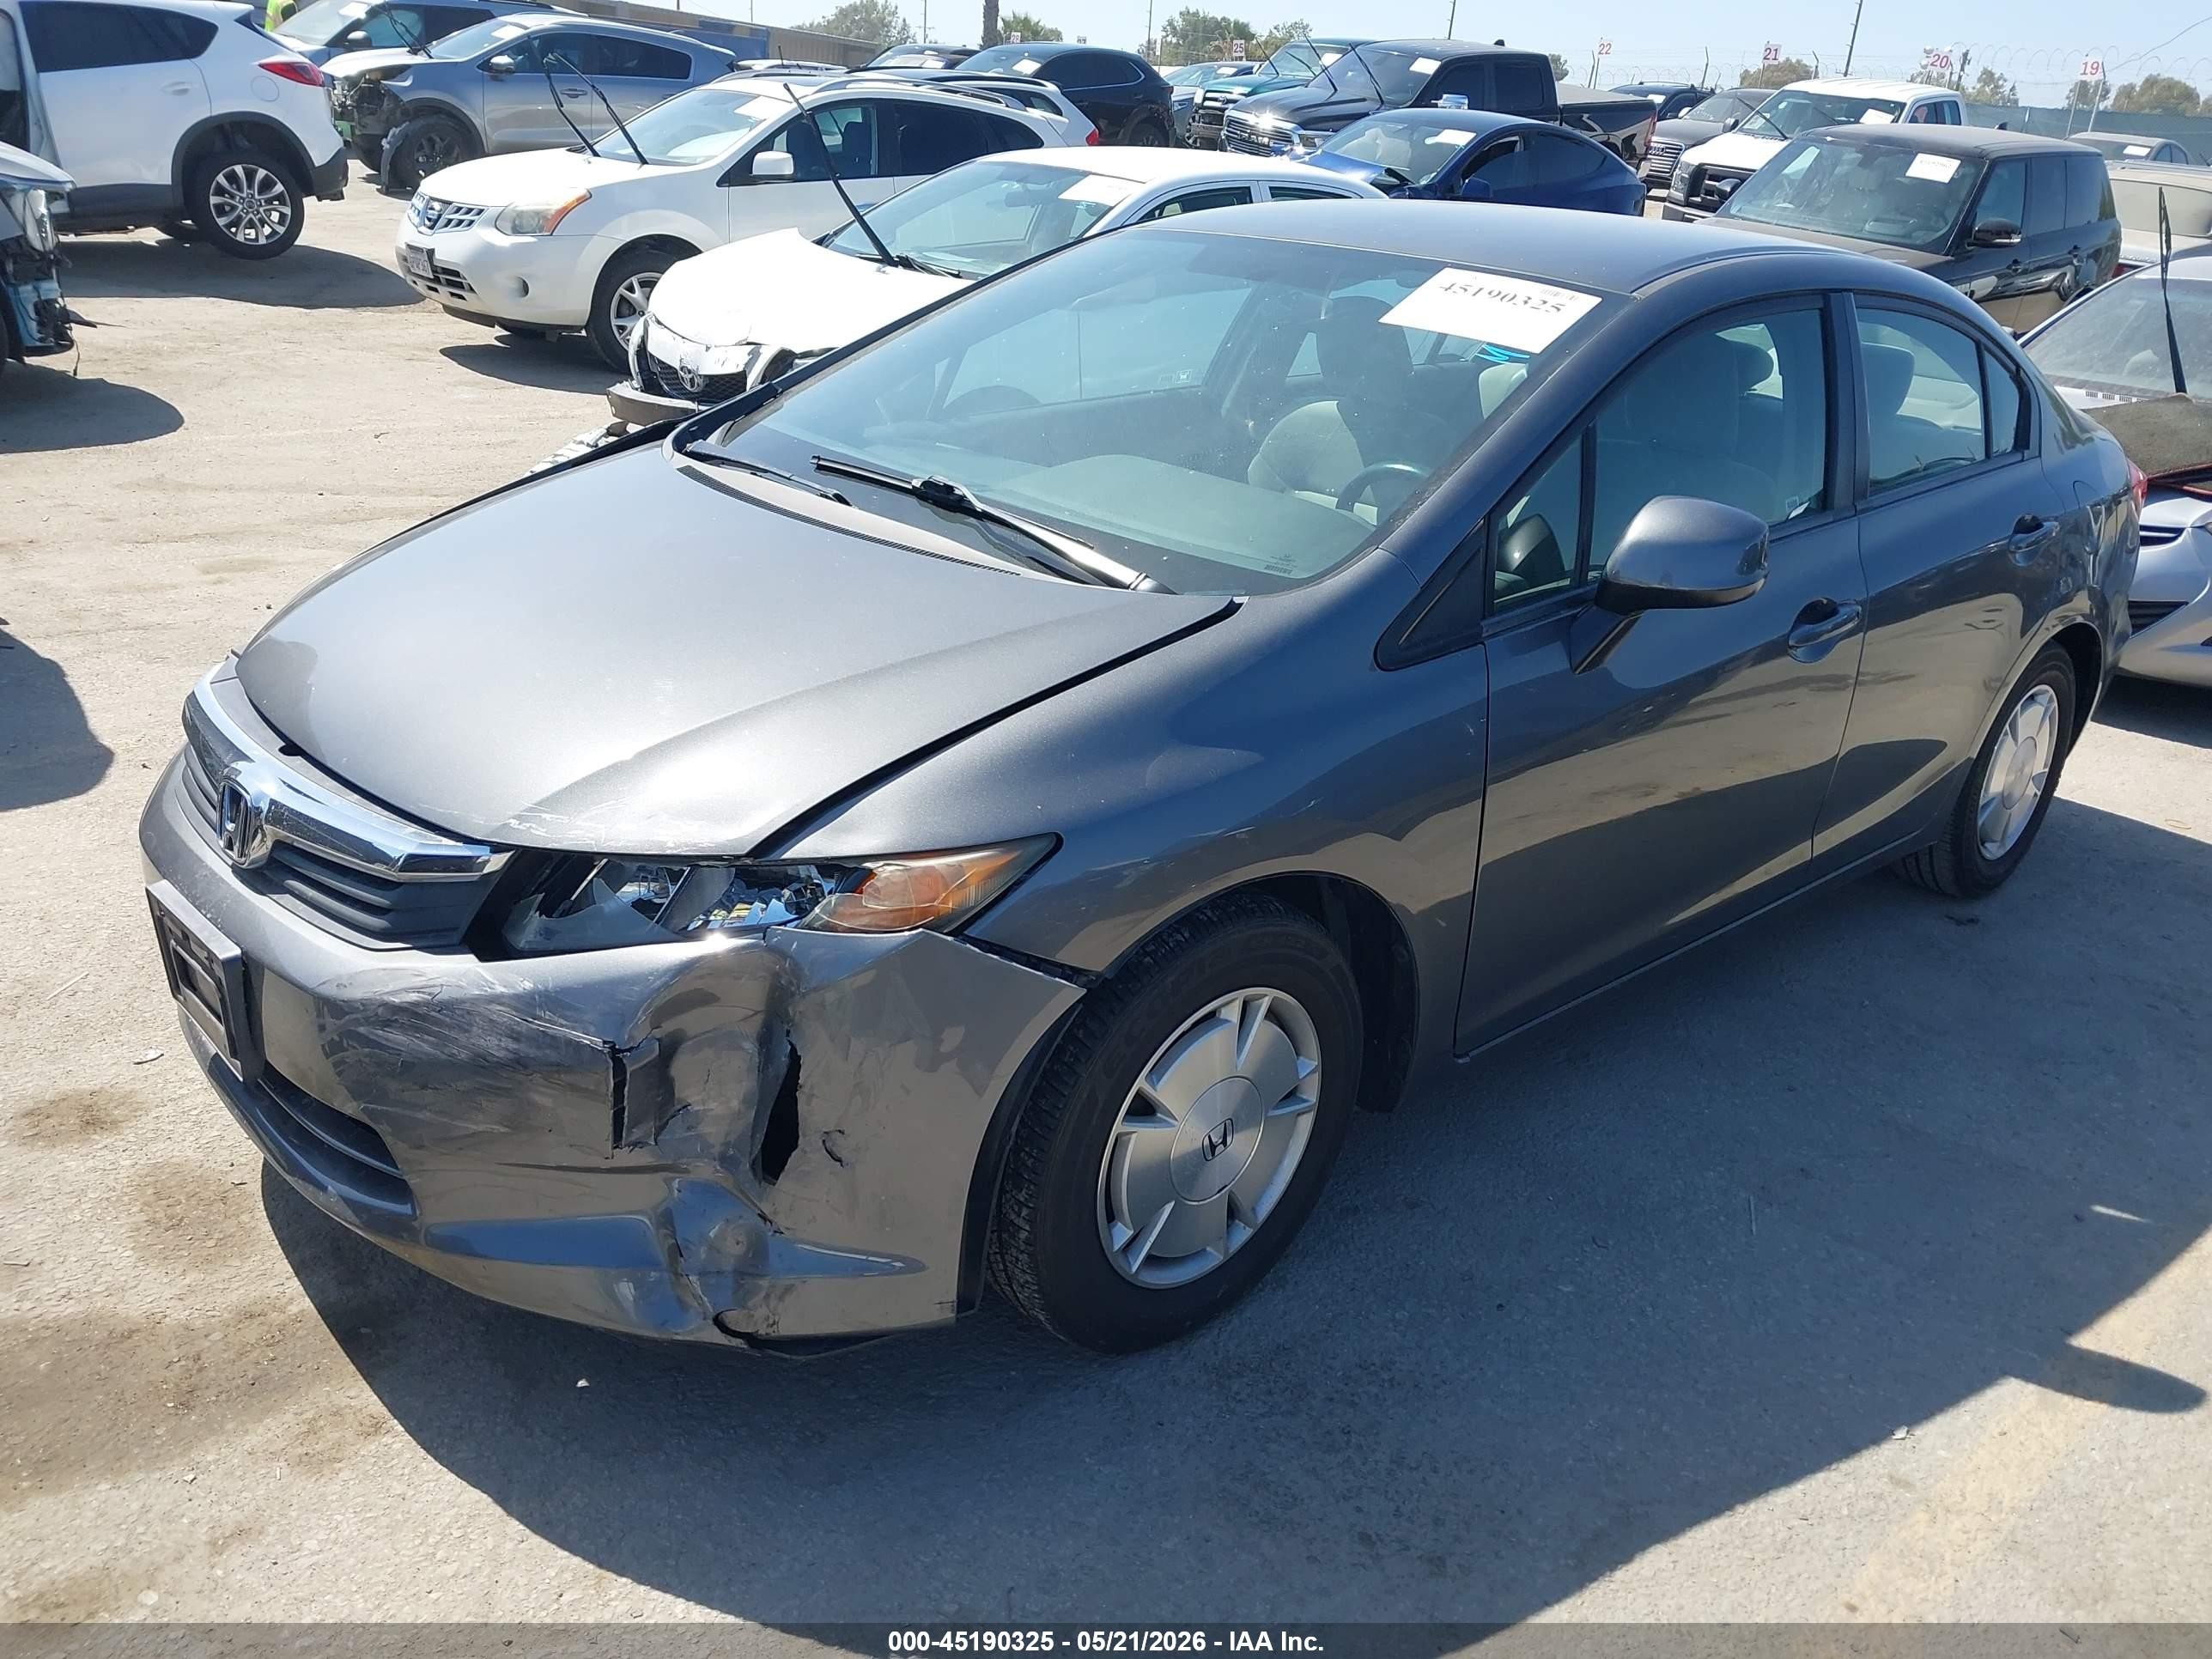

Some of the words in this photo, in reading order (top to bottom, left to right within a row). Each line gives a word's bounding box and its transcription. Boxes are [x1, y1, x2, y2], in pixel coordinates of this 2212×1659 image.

[1233, 42, 1244, 53] 25
[1598, 42, 1612, 55] 22
[1763, 47, 1779, 61] 21
[1929, 53, 1949, 69] 20
[2080, 61, 2100, 76] 19
[1438, 282, 1567, 313] 45190325
